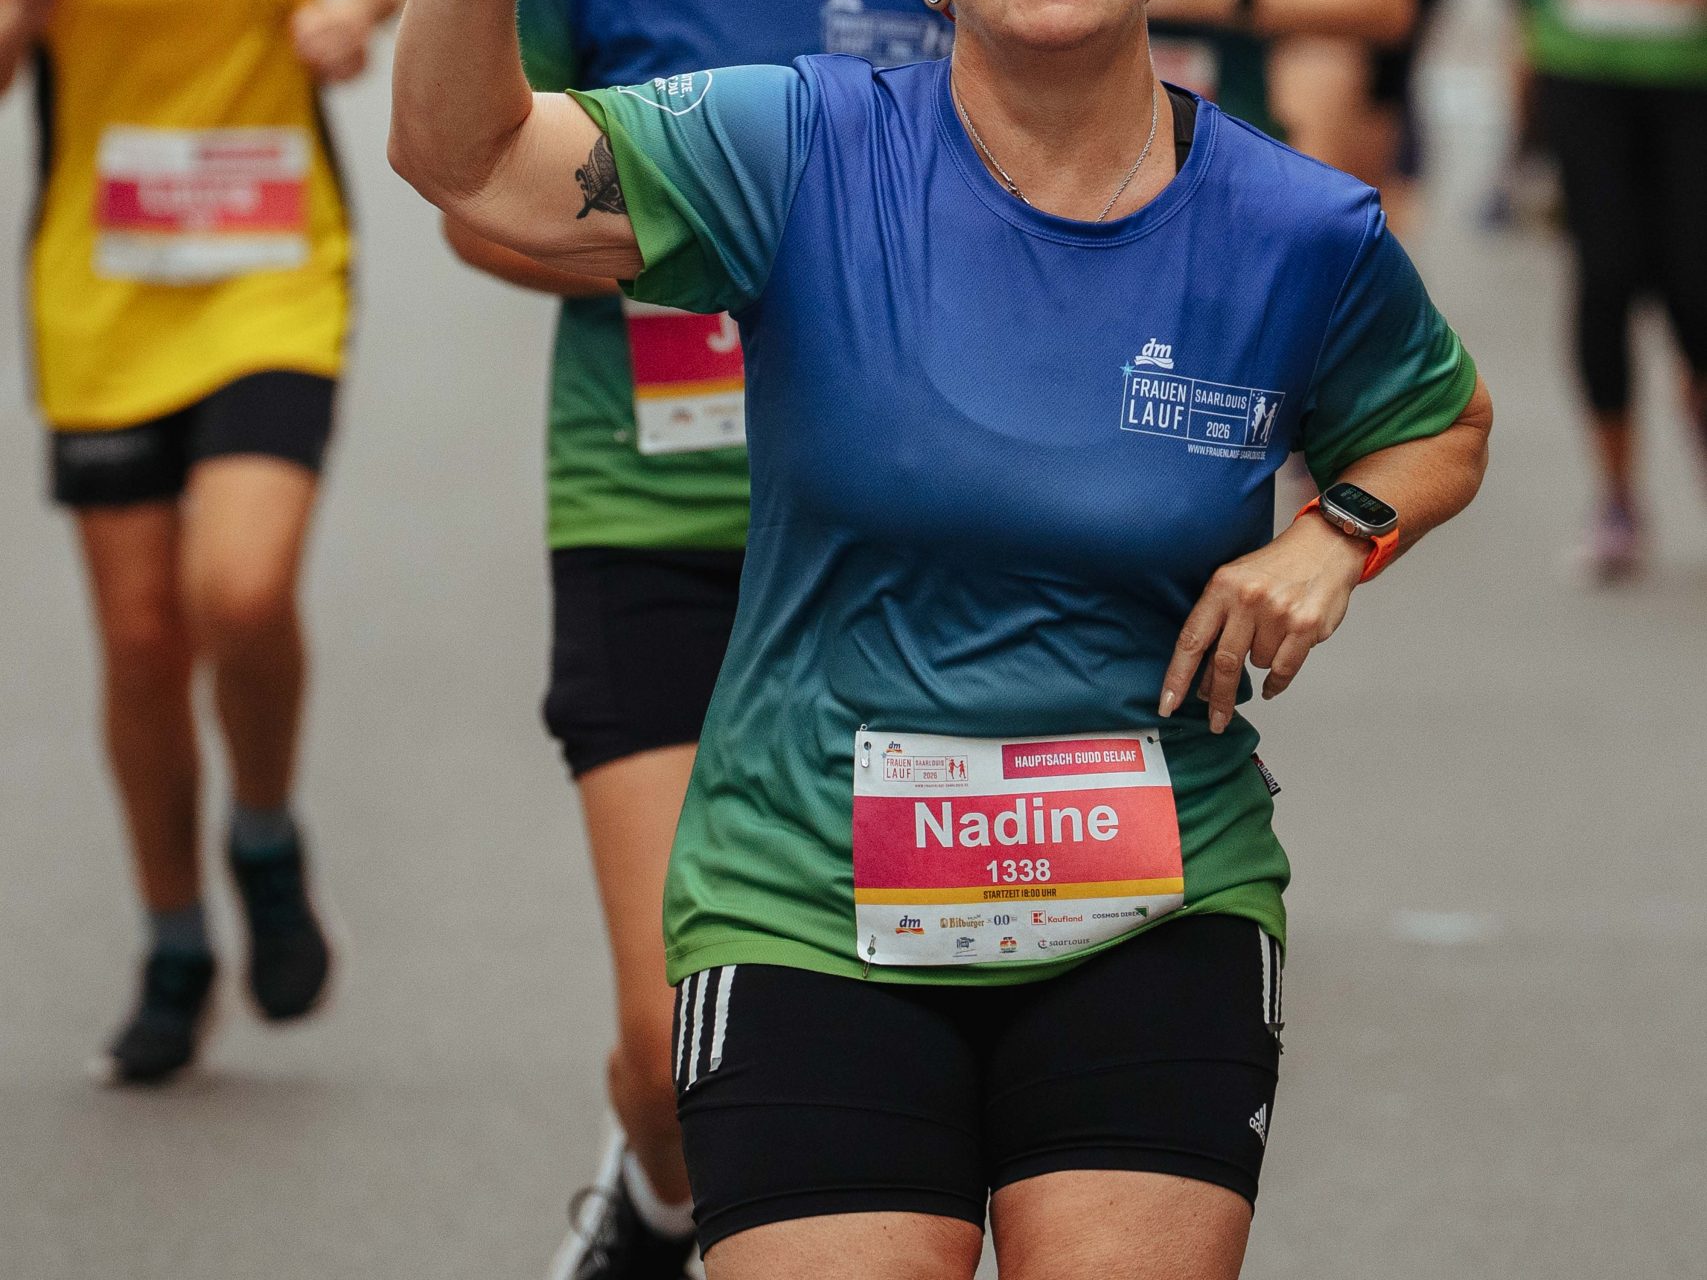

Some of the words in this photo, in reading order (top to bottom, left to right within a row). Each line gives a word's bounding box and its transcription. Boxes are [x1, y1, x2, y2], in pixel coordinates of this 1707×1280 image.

[1141, 338, 1172, 358] dm
[1131, 377, 1187, 403] FRAUEN
[1194, 389, 1247, 410] SAARLOUIS
[1128, 399, 1185, 430] LAUF
[1206, 421, 1231, 439] 2026
[886, 758, 912, 767] FRAUEN
[1015, 753, 1073, 768] HAUPTSACH
[1075, 751, 1101, 764] GUDD
[1103, 750, 1136, 763] GELAAF
[886, 768, 912, 779] LAUF
[923, 771, 937, 780] 2026
[914, 797, 1119, 848] Nadine
[986, 858, 1051, 883] 1338
[983, 889, 1020, 899] STARTZEIT
[1021, 888, 1040, 898] 18:00
[1041, 888, 1057, 896] UHR
[899, 915, 921, 928] dm
[1047, 915, 1083, 923] Kaufland
